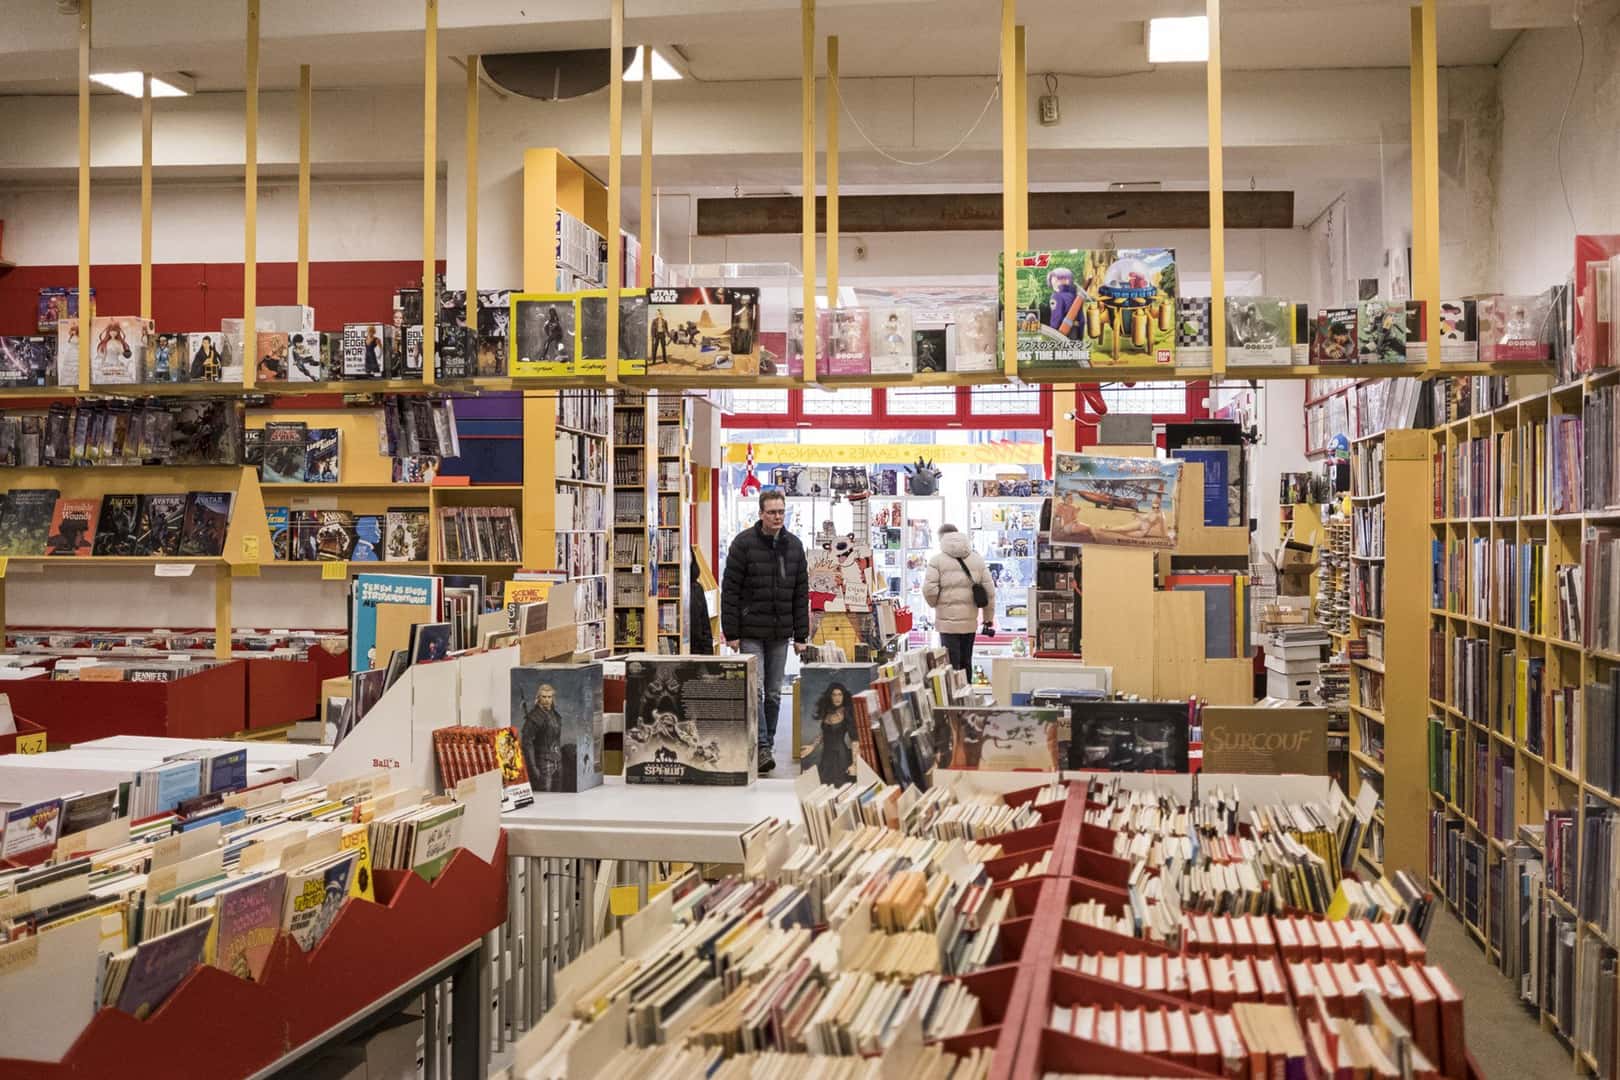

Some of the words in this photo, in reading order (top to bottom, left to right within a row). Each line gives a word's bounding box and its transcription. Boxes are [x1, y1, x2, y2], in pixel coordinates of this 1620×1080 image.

[653, 289, 677, 297] STAR
[345, 348, 363, 356] WOR
[1035, 351, 1054, 360] TIME
[1055, 351, 1091, 361] MACHINE
[152, 497, 180, 505] AVATAR
[195, 496, 223, 505] AVATAR
[62, 511, 92, 520] Wounds
[362, 582, 392, 593] TEKEN
[131, 671, 168, 682] JENNIFER
[1209, 726, 1313, 752] SURCOUF
